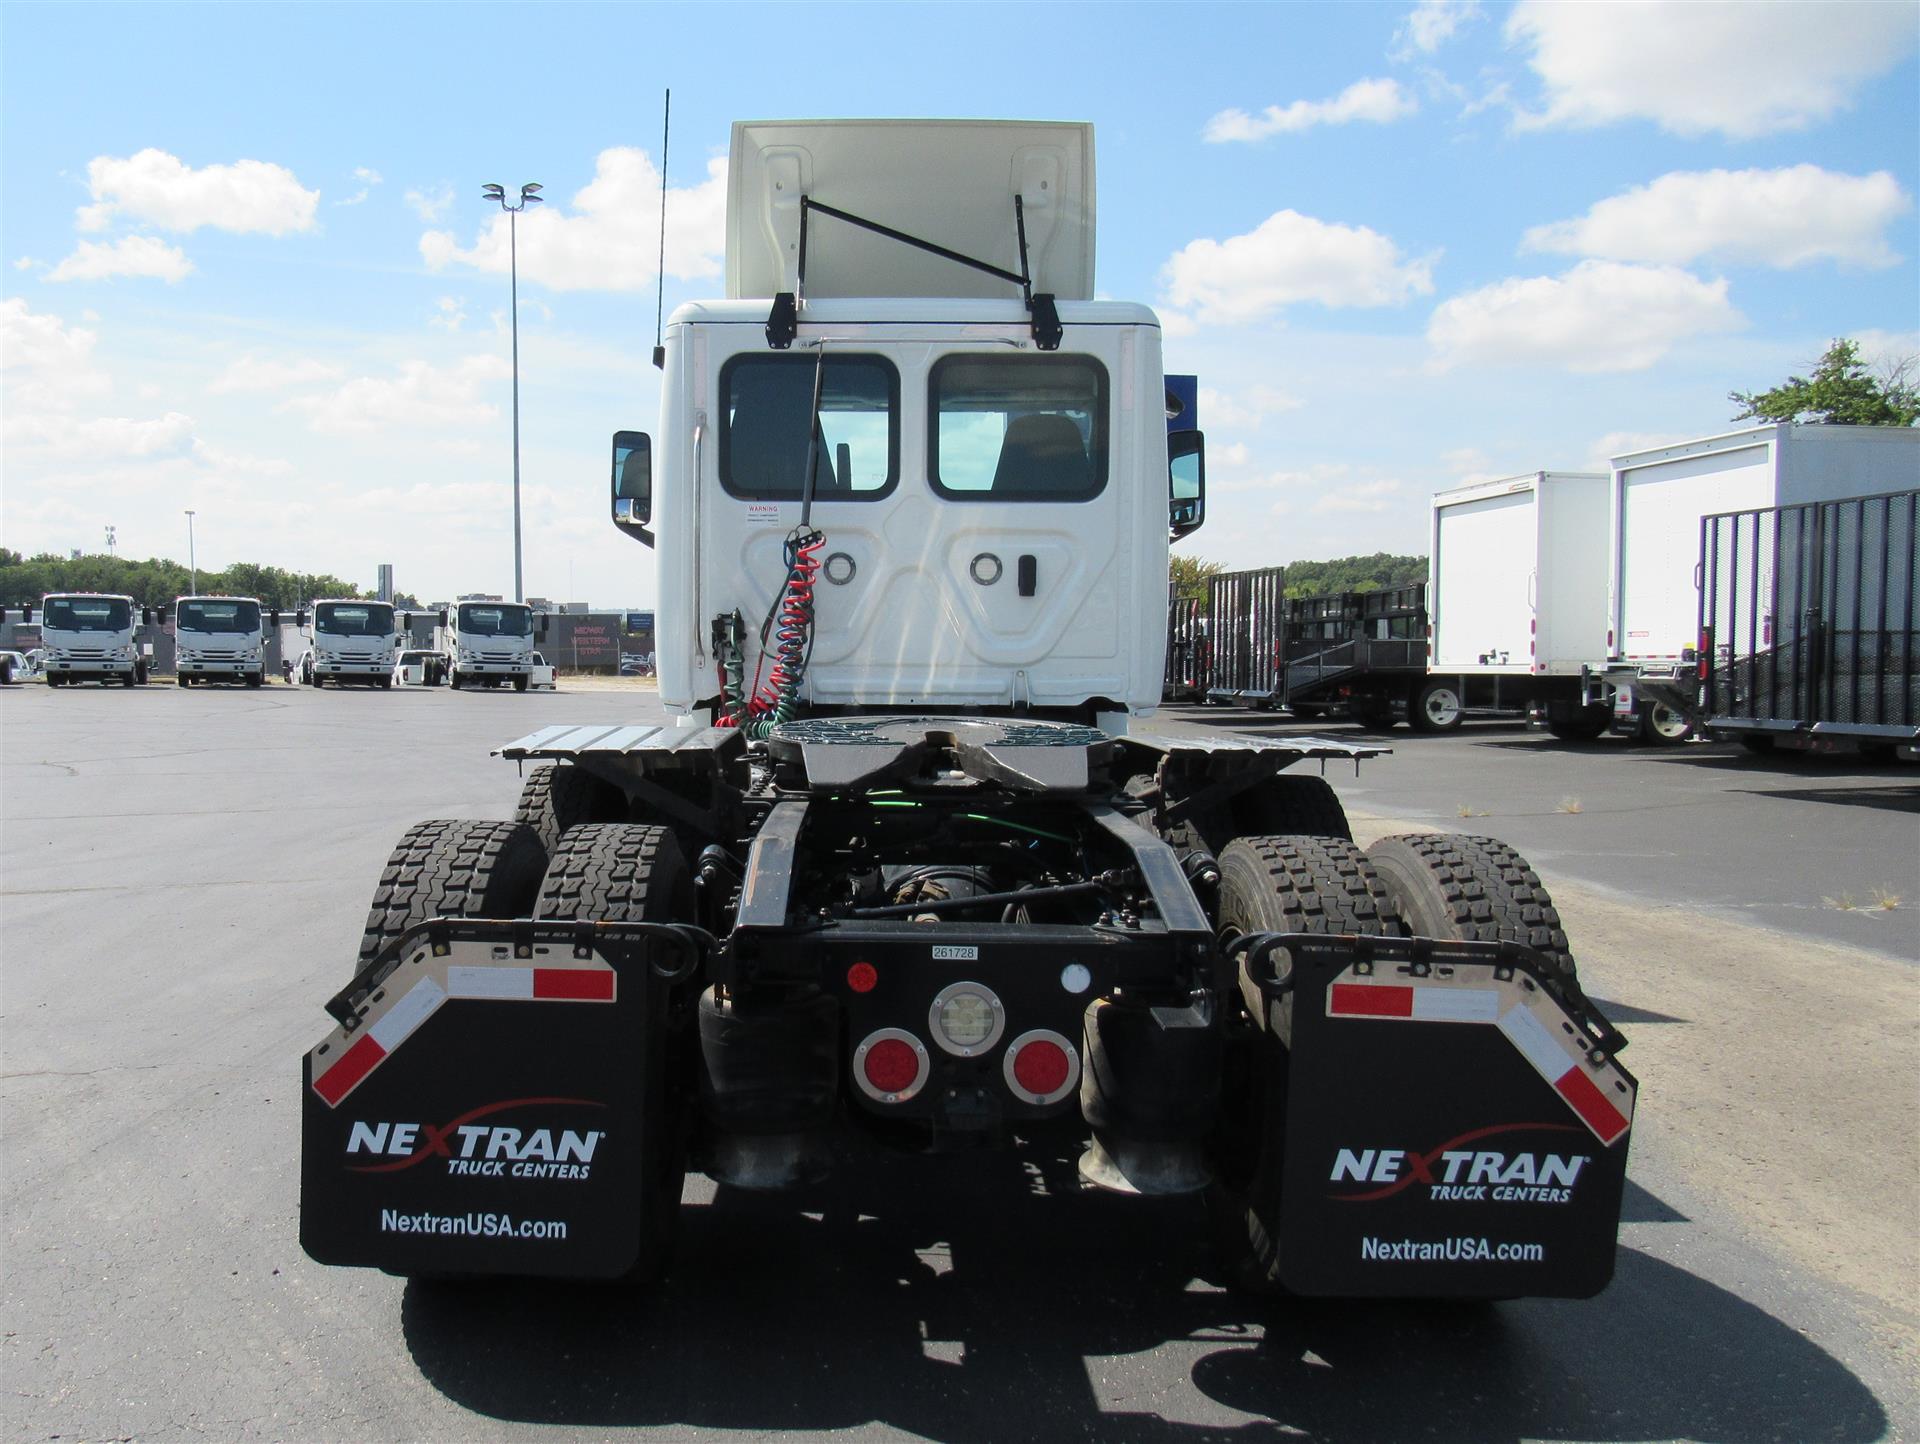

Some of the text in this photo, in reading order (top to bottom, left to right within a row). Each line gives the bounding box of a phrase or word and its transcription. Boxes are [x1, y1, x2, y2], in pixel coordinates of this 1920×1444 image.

[934, 947, 974, 958] 261728
[346, 1121, 600, 1162] NEXTRAN
[448, 1160, 590, 1179] TRUCK CENTERS
[1329, 1148, 1585, 1186] NEXTRAN
[1430, 1185, 1571, 1202] TRUCK CENTERS
[381, 1209, 567, 1239] NextranUSA.com
[1361, 1236, 1543, 1261] NextranUSA.com
